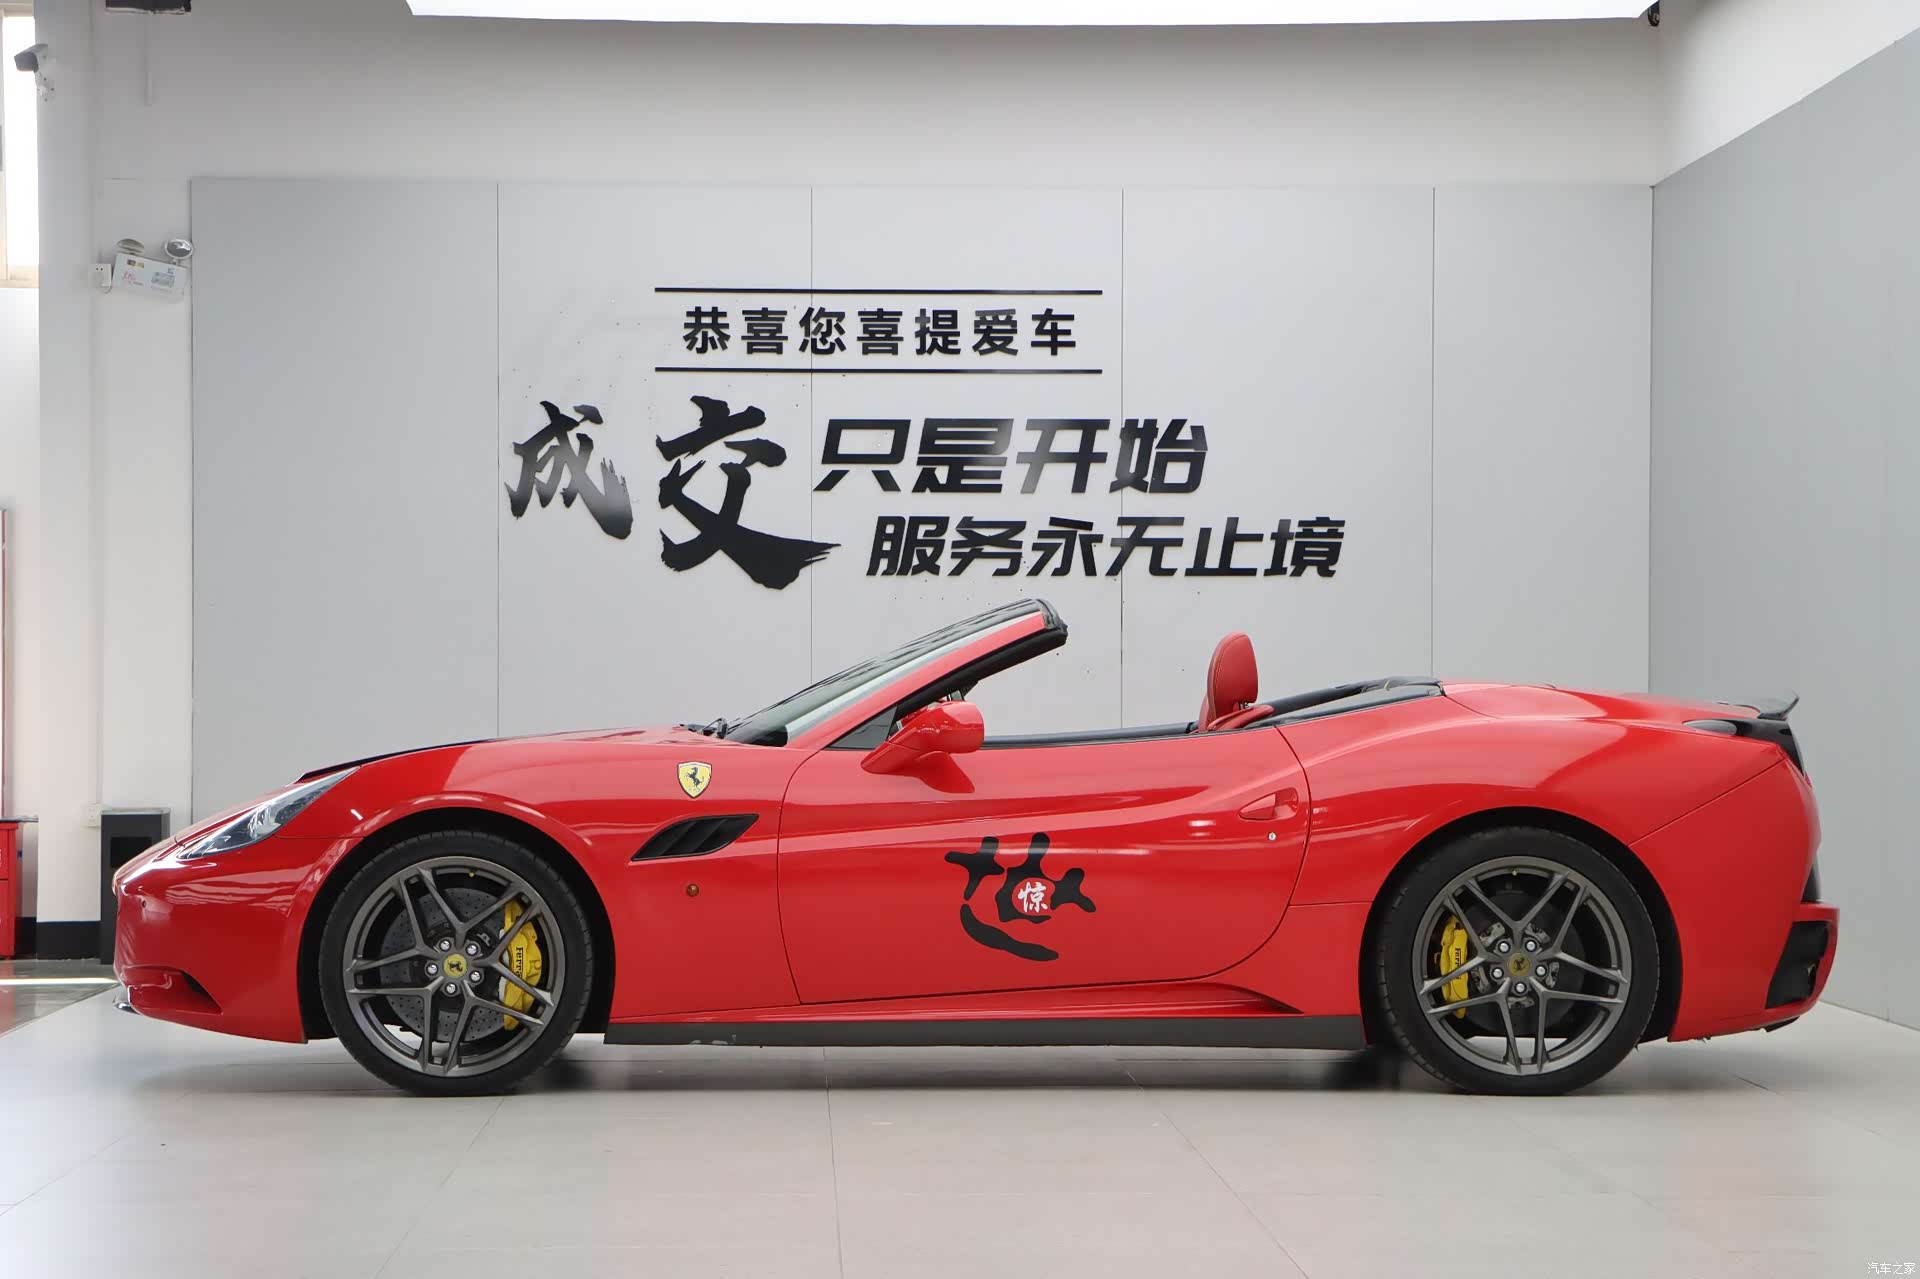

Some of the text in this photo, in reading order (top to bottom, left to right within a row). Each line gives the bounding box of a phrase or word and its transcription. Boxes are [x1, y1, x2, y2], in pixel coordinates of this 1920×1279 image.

[682, 306, 1076, 356] 恭喜您喜提爱车
[812, 418, 1209, 494] 只是开始
[504, 395, 841, 590] 成交
[866, 515, 1346, 578] 服务永无止境
[1017, 881, 1049, 913] 惊
[516, 947, 524, 979] Ferra
